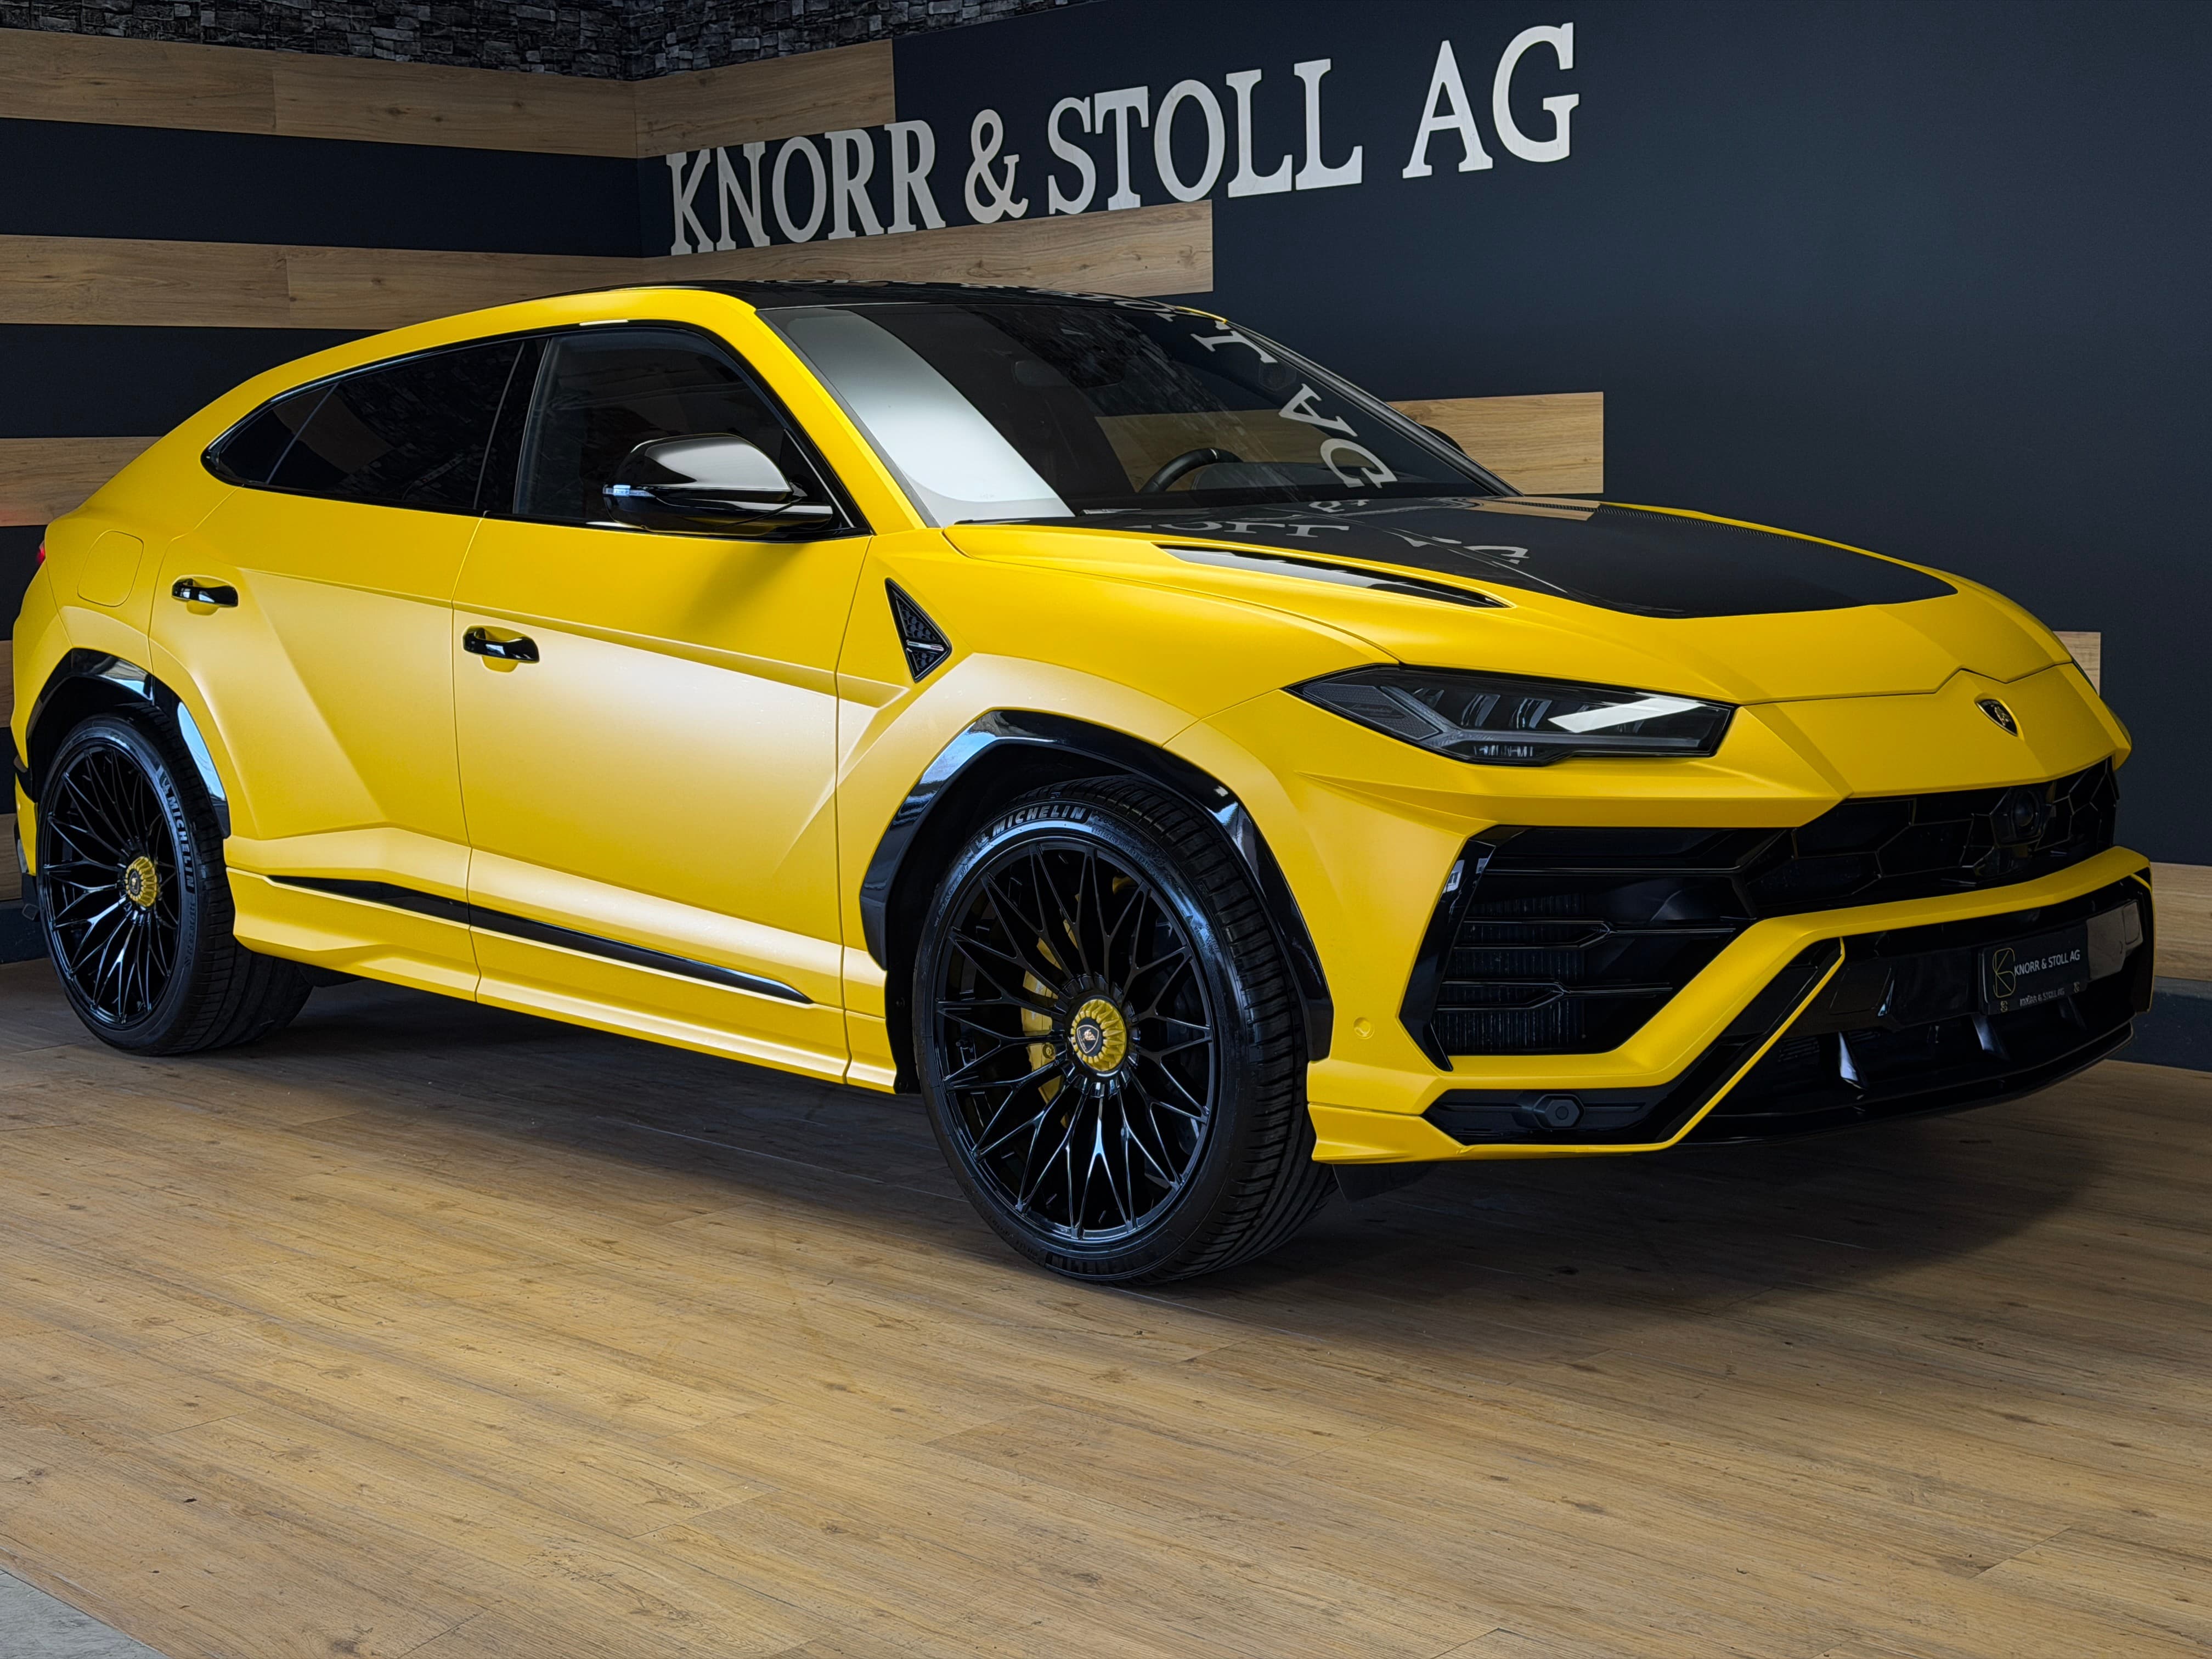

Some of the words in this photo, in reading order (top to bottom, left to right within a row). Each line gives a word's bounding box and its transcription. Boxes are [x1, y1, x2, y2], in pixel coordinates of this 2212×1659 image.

[667, 120, 946, 256] KNORR
[964, 109, 1029, 224] &
[1048, 58, 1363, 215] STOLL
[1402, 22, 1579, 179] AG
[167, 795, 195, 888] MICHELIN
[992, 804, 1087, 836] MICHELIN
[2014, 960, 2040, 976] KNORR
[2041, 958, 2047, 969] &
[2049, 952, 2069, 968] STOLL
[2070, 949, 2080, 962] AG
